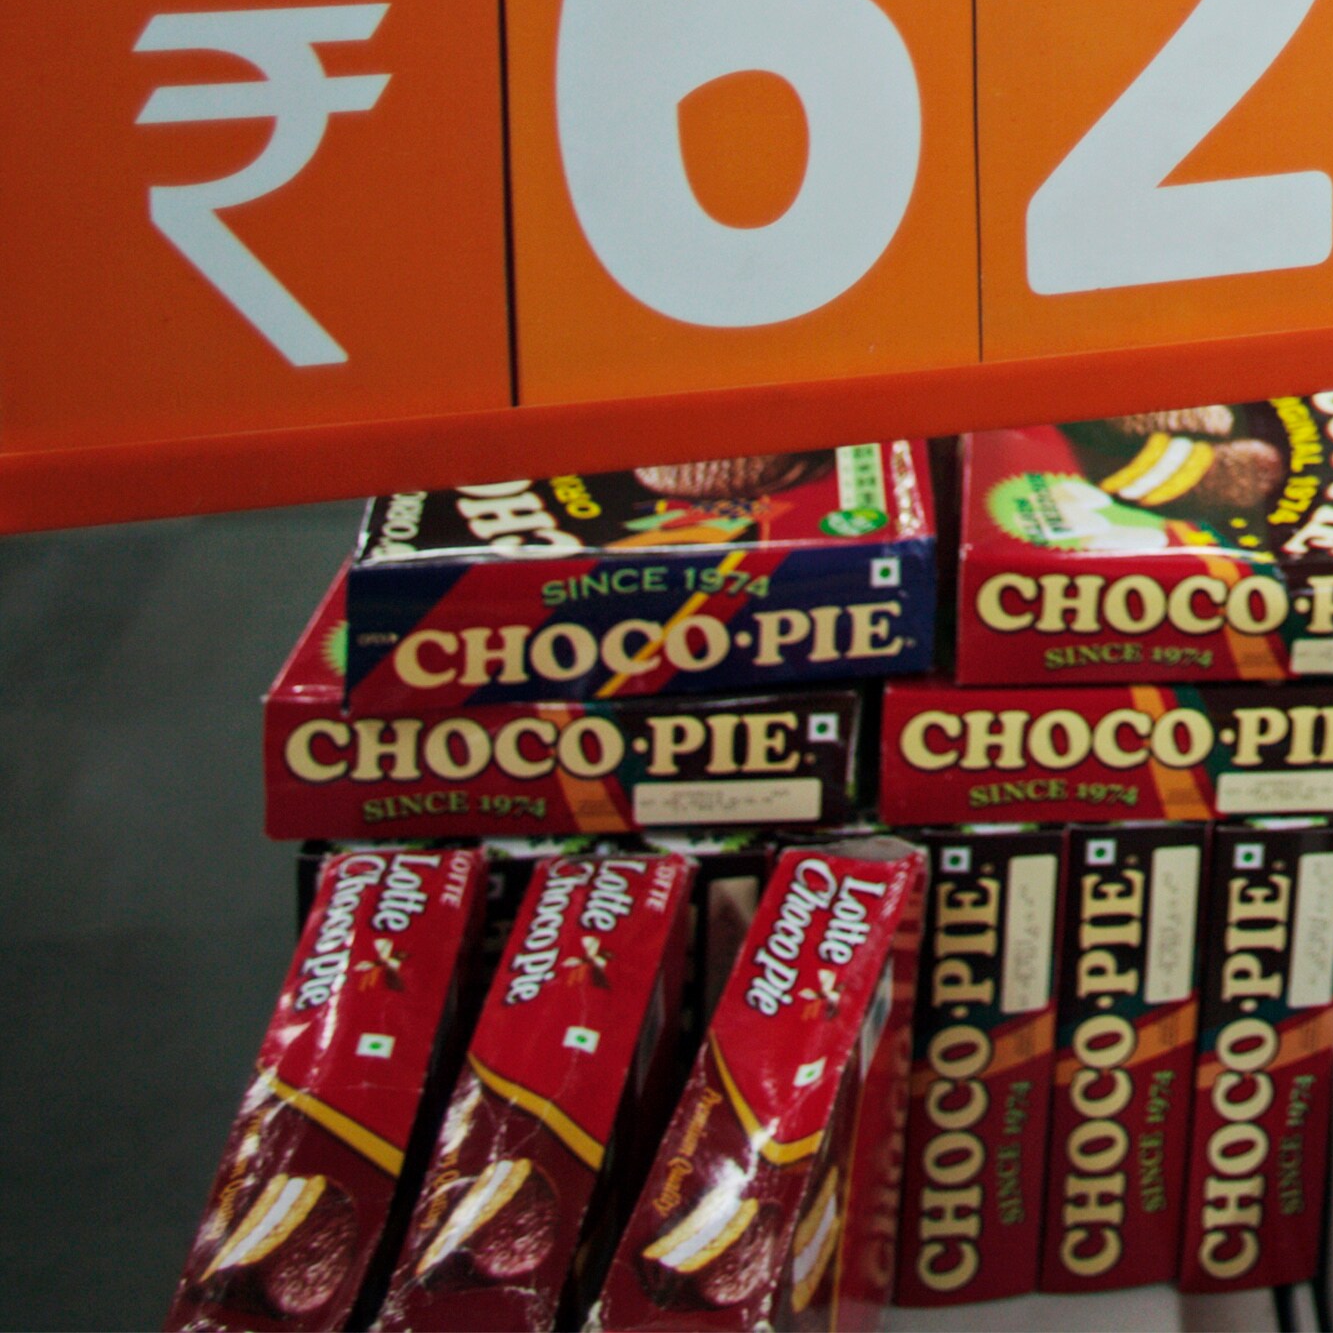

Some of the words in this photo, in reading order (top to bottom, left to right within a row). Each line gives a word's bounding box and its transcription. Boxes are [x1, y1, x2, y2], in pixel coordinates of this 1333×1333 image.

[542, 567, 666, 605] SINCE
[684, 566, 770, 599] 1974
[1044, 643, 1142, 669] SINCE
[1150, 644, 1213, 667] 1974
[362, 792, 469, 821] SINCE
[479, 795, 546, 818] 1974
[970, 781, 1066, 807] SINCE
[1076, 782, 1139, 805] 1974
[315, 854, 387, 953] Choco
[372, 854, 441, 932] Lotte
[525, 859, 593, 950] Choco
[580, 860, 647, 931] Lotte
[768, 859, 837, 960] Choco
[818, 876, 887, 964] Lotte
